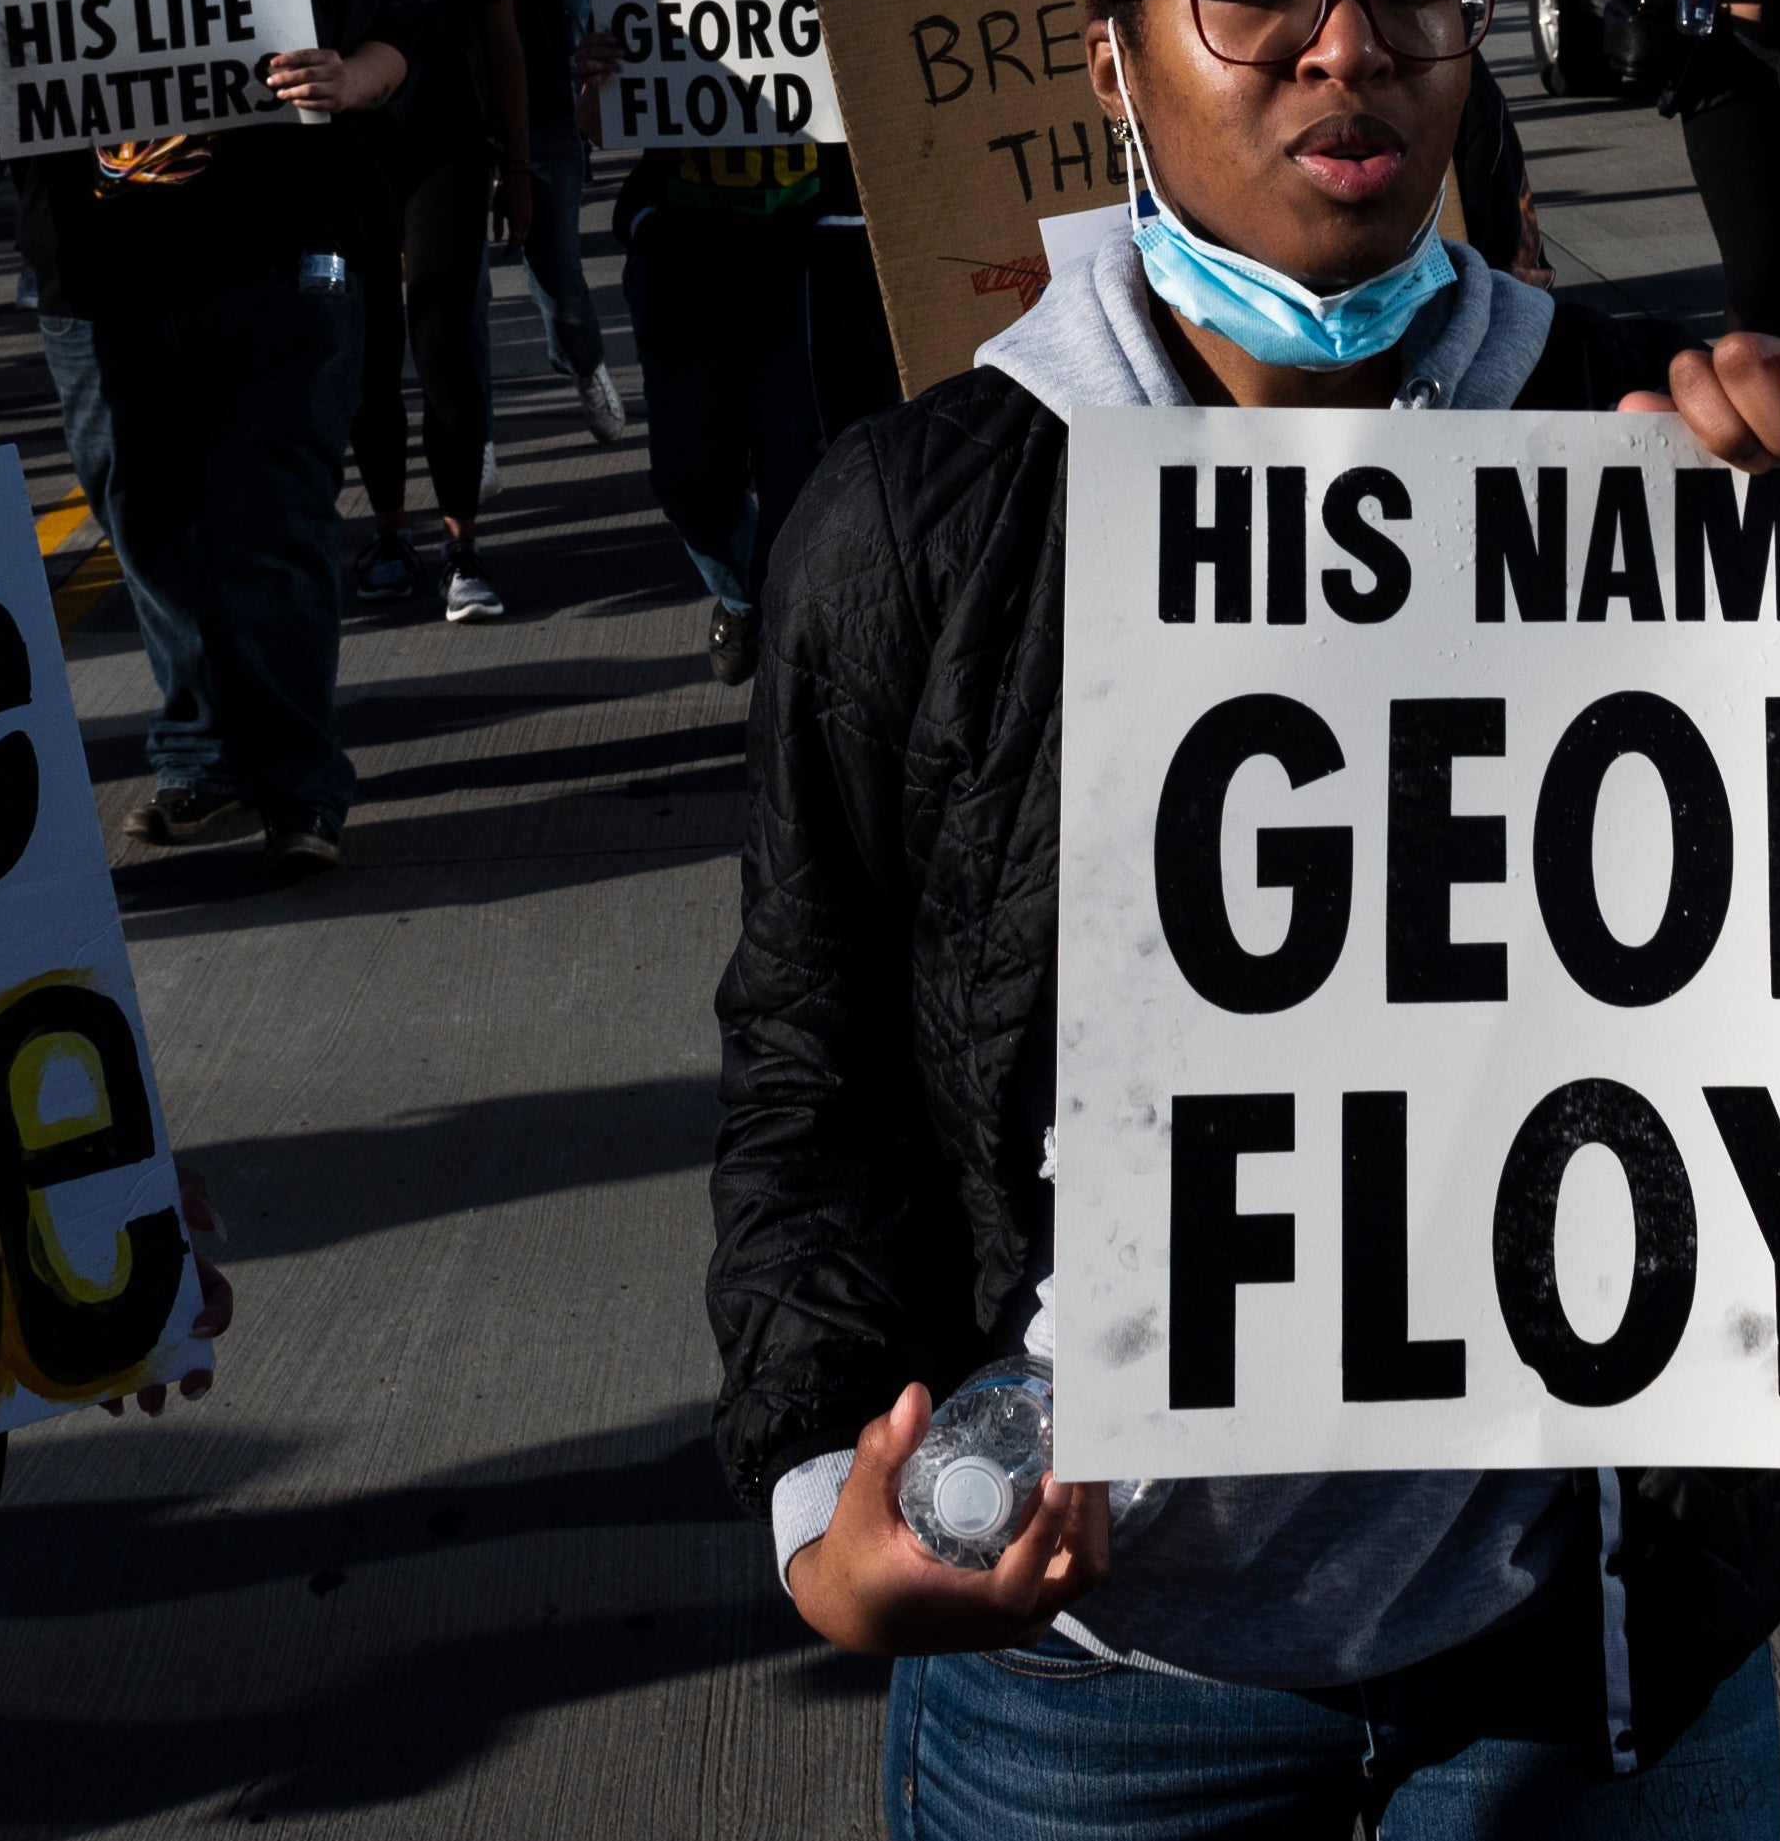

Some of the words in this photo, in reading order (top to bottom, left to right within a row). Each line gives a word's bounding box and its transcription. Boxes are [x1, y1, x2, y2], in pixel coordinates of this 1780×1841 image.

[17, 52, 291, 143] MATTERS
[908, 1, 1088, 107] BRE
[619, 73, 813, 137] FLOYD
[1157, 465, 1412, 624] HIS
